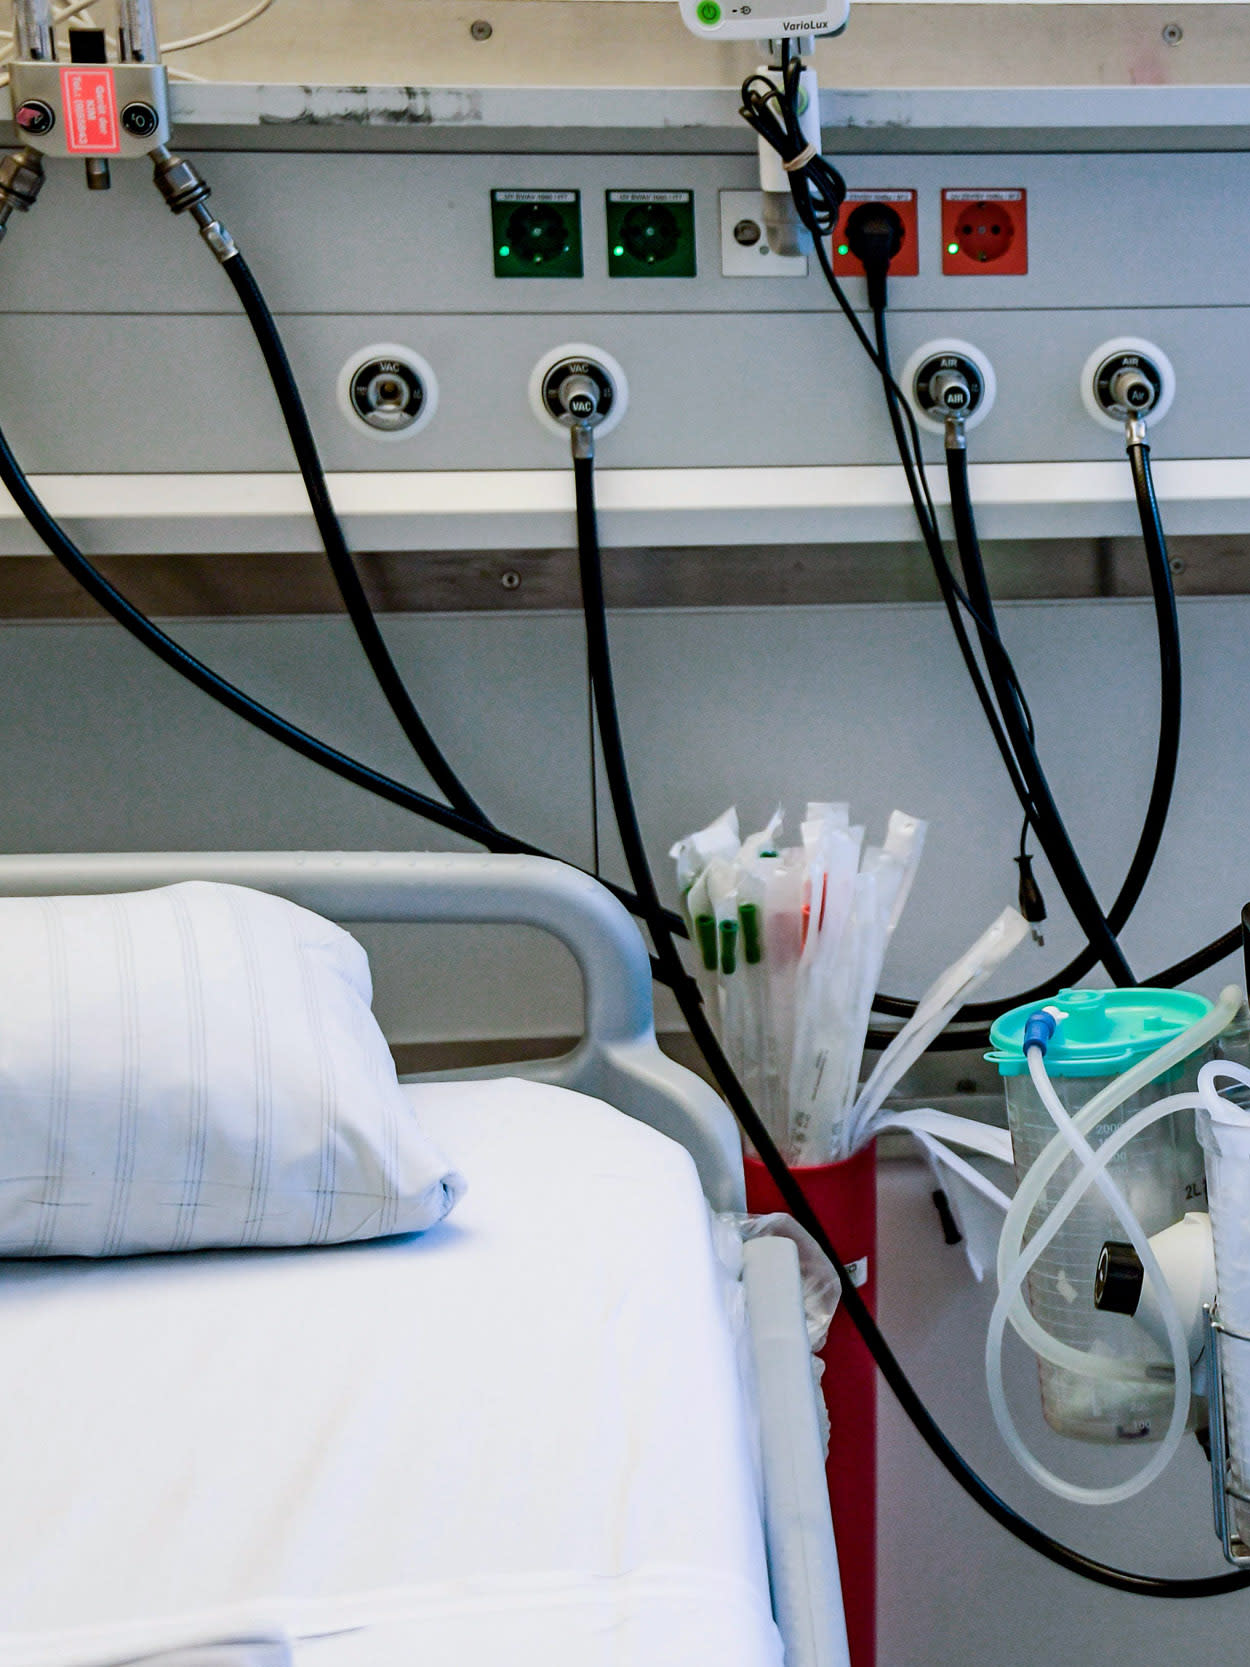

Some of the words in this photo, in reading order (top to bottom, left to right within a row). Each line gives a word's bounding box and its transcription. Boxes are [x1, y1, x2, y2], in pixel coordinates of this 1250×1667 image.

[782, 20, 829, 31] VarioLux
[379, 361, 400, 373] VAC
[939, 358, 958, 369] AIR
[1122, 357, 1139, 367] AIR
[569, 363, 589, 374] VAC
[946, 393, 964, 404] AIR
[1131, 390, 1145, 400] Air
[571, 400, 592, 412] VAC
[1184, 1183, 1201, 1200] 2L
